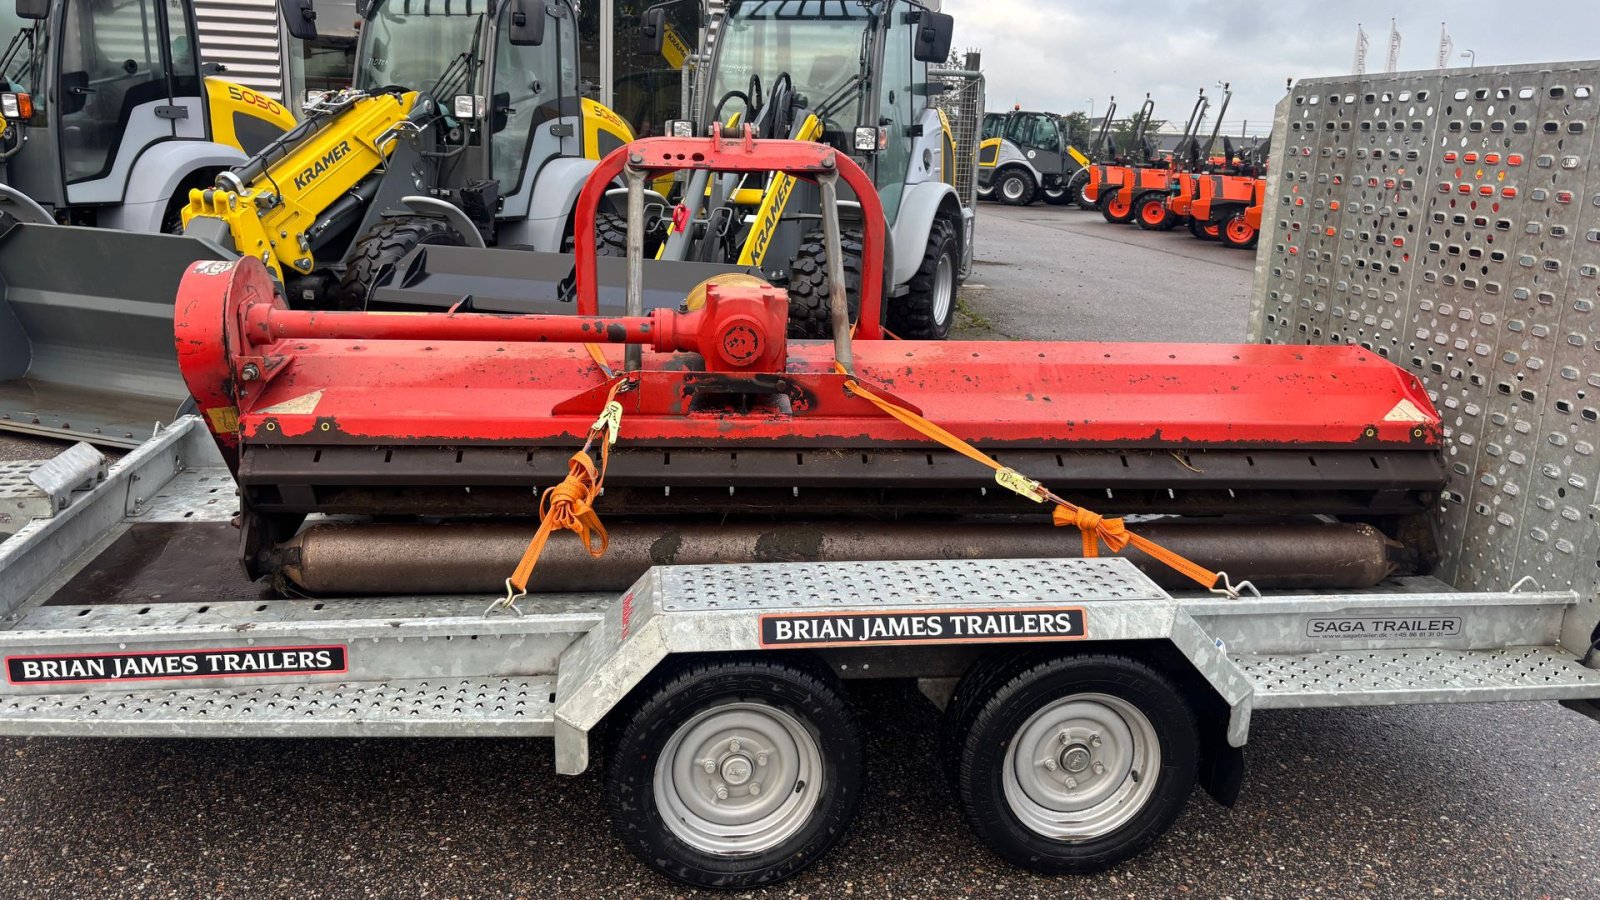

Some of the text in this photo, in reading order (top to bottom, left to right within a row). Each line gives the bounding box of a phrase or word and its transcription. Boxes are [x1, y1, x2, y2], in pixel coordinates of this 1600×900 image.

[228, 86, 281, 115] 5050
[293, 140, 352, 191] KRAMER
[750, 173, 792, 266] KRAMER
[775, 613, 1072, 641] BRIAN JAMES TRAILERS
[1312, 620, 1455, 633] SAGA TRAILER
[22, 650, 333, 679] BRIAN JAMES TRAILERS
